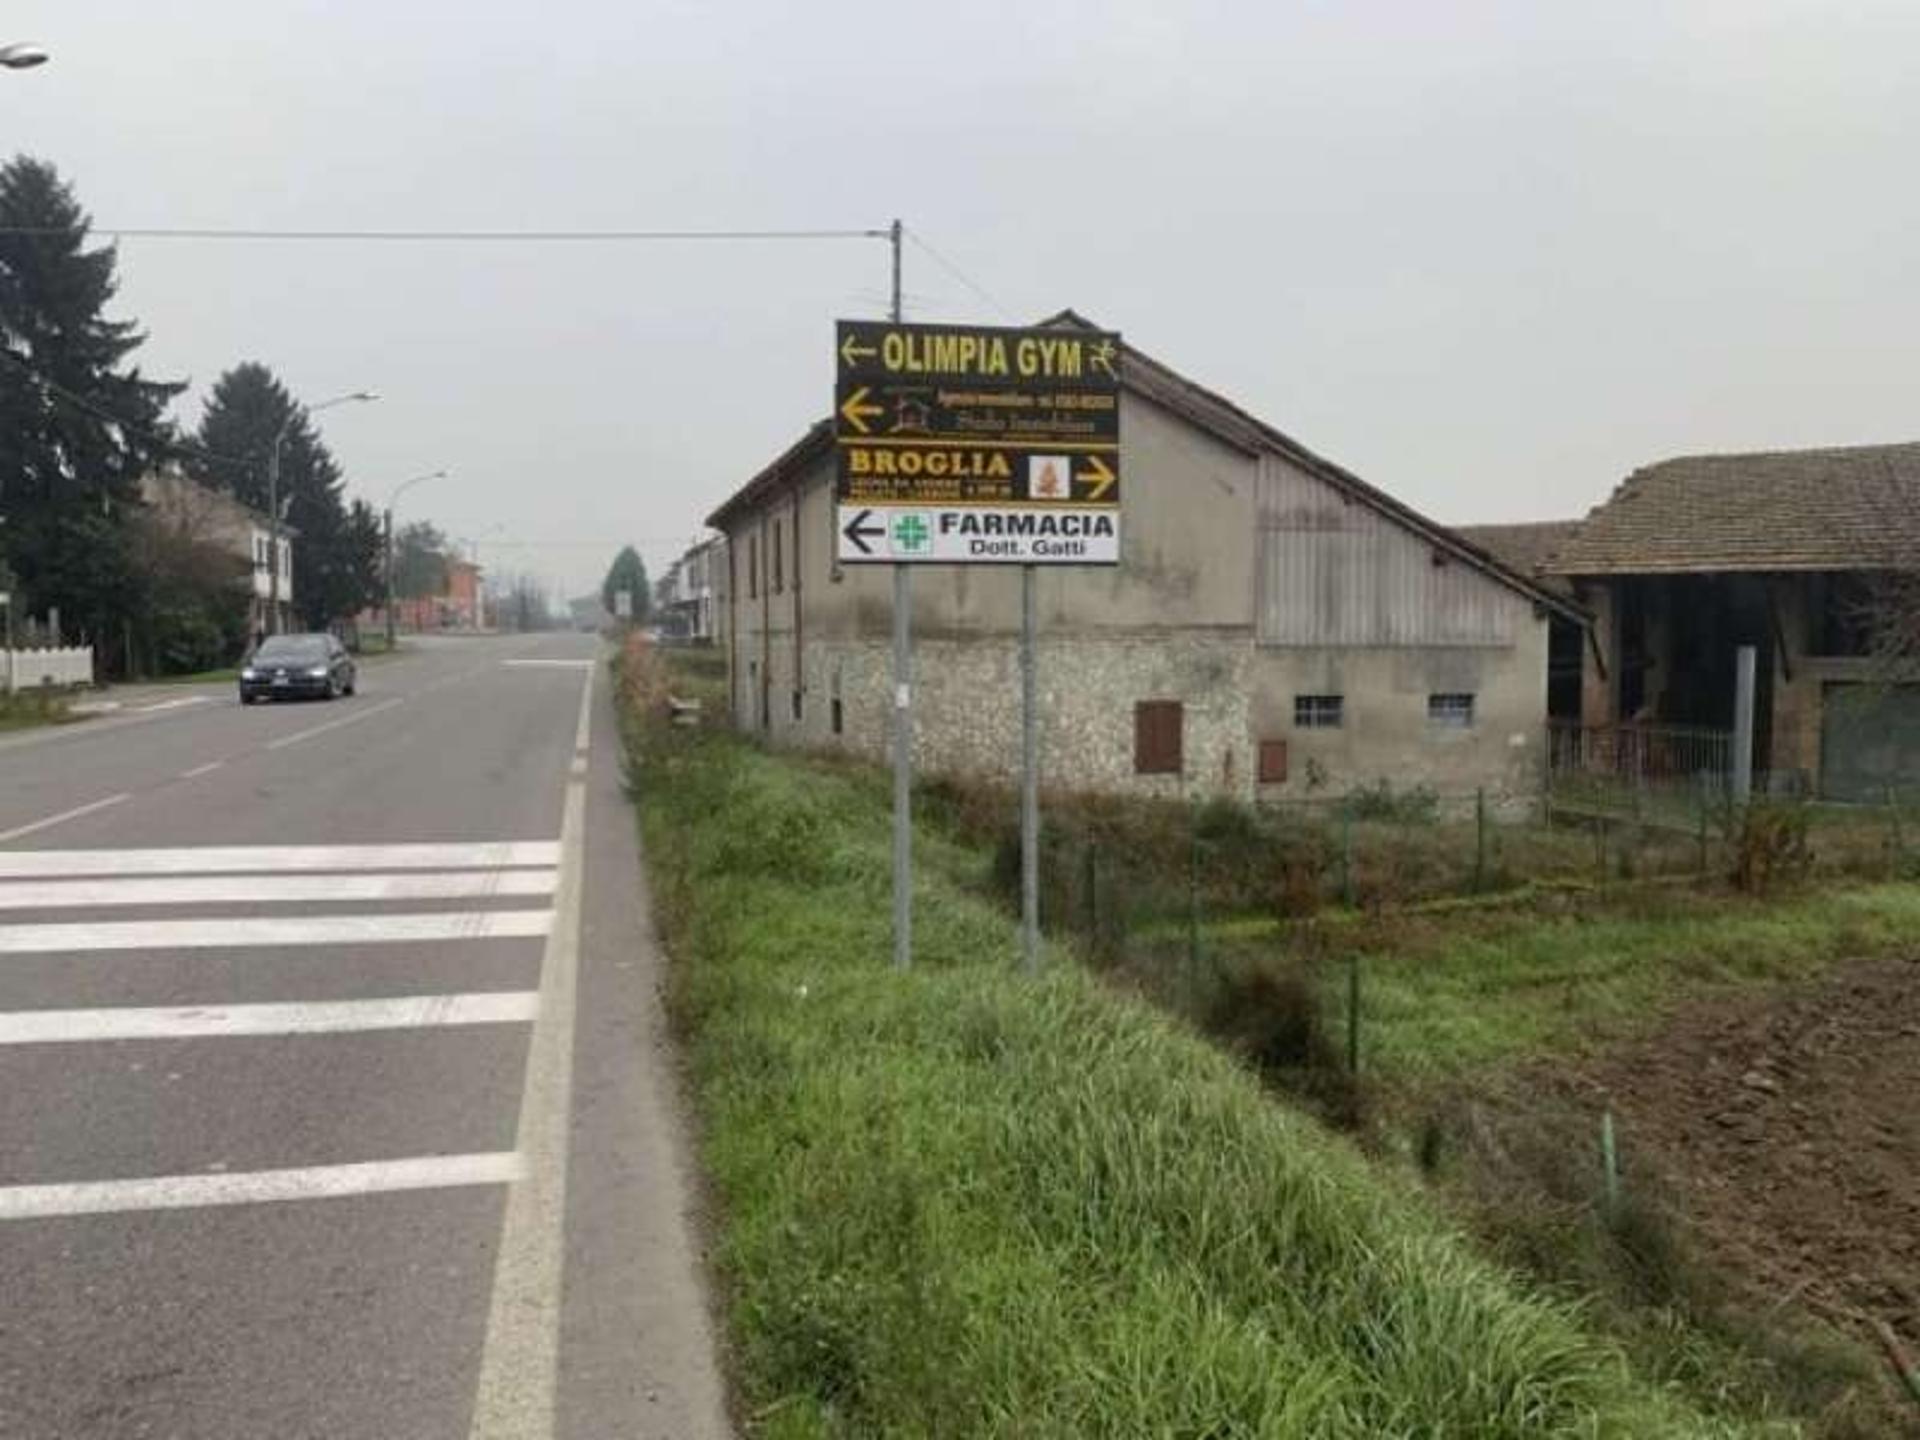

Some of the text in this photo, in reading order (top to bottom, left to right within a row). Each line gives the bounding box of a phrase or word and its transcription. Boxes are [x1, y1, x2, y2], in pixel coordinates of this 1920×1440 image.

[883, 332, 1082, 376] OLIMPIA GYM
[850, 449, 1011, 475] BROGLIA
[940, 512, 1114, 537] FARMACIA
[970, 539, 1086, 556] Dott. Gatti
